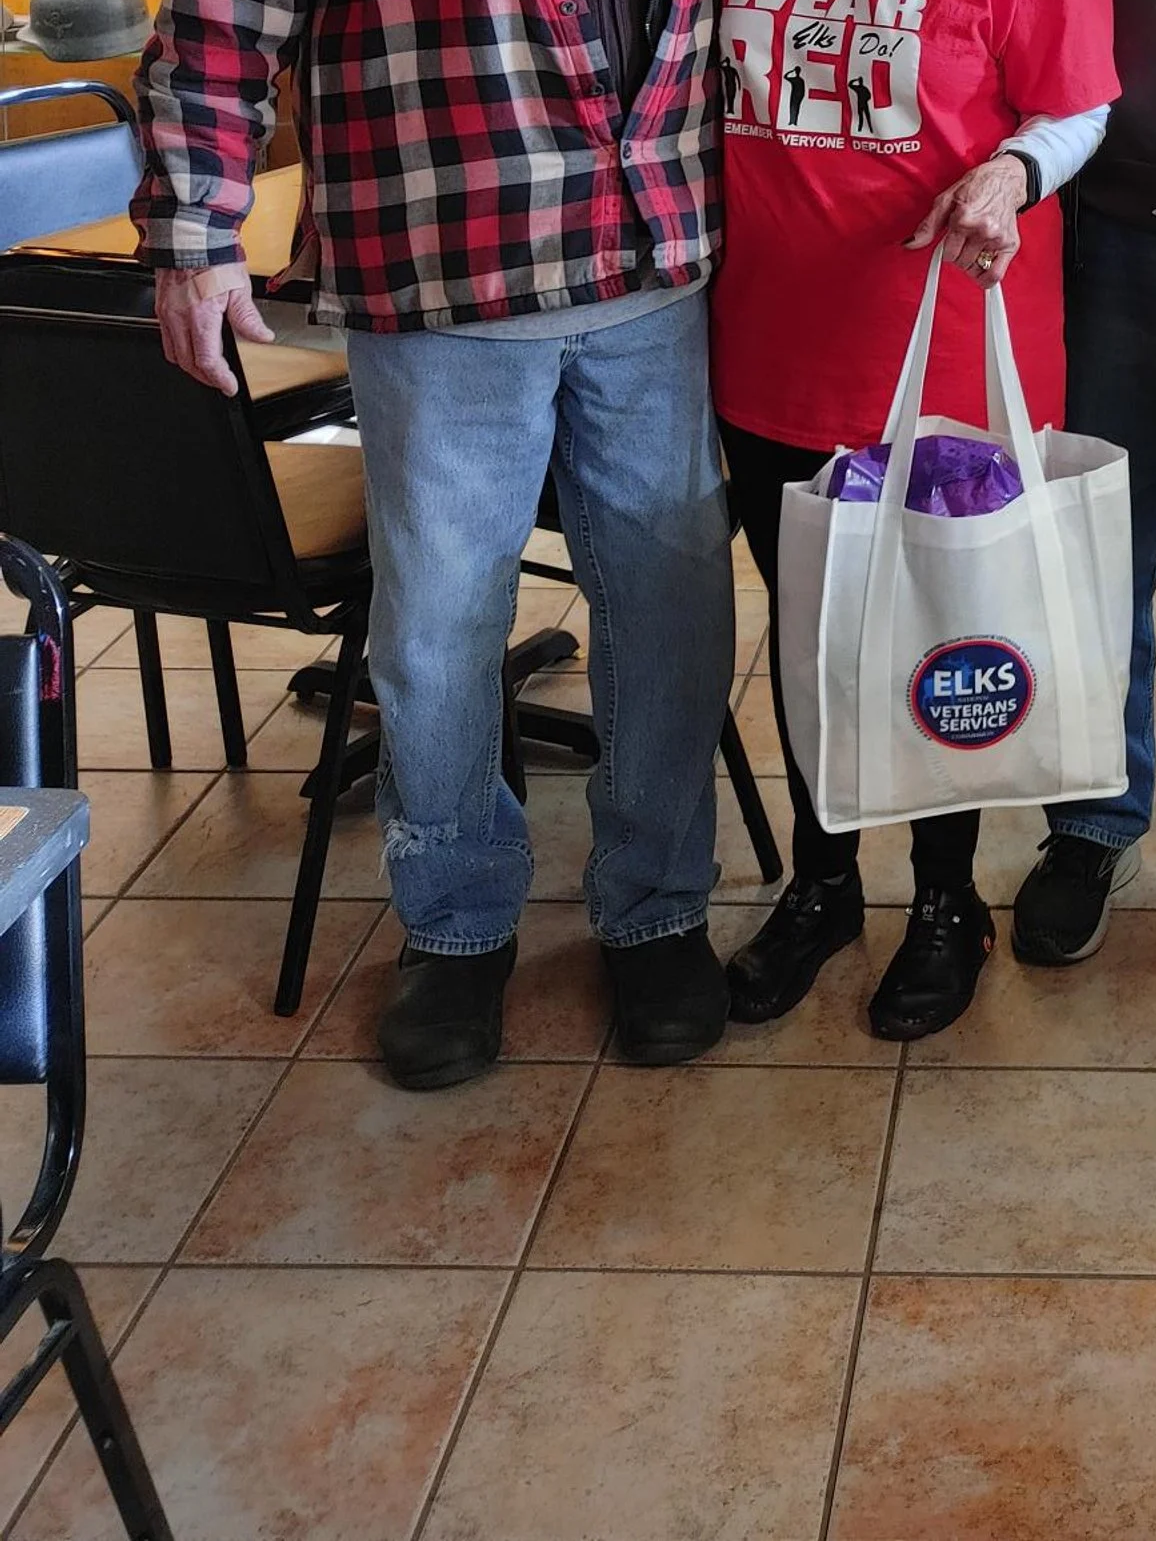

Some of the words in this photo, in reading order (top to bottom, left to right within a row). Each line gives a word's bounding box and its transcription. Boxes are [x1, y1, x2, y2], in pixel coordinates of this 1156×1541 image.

[792, 21, 837, 51] Elks
[719, 7, 921, 140] RED
[724, 121, 773, 140] EMEMBER
[852, 139, 921, 155] DEPLOYED
[933, 661, 1016, 697] ELKS
[929, 698, 1018, 718] VETERANS
[939, 713, 1008, 732] SERVICE
